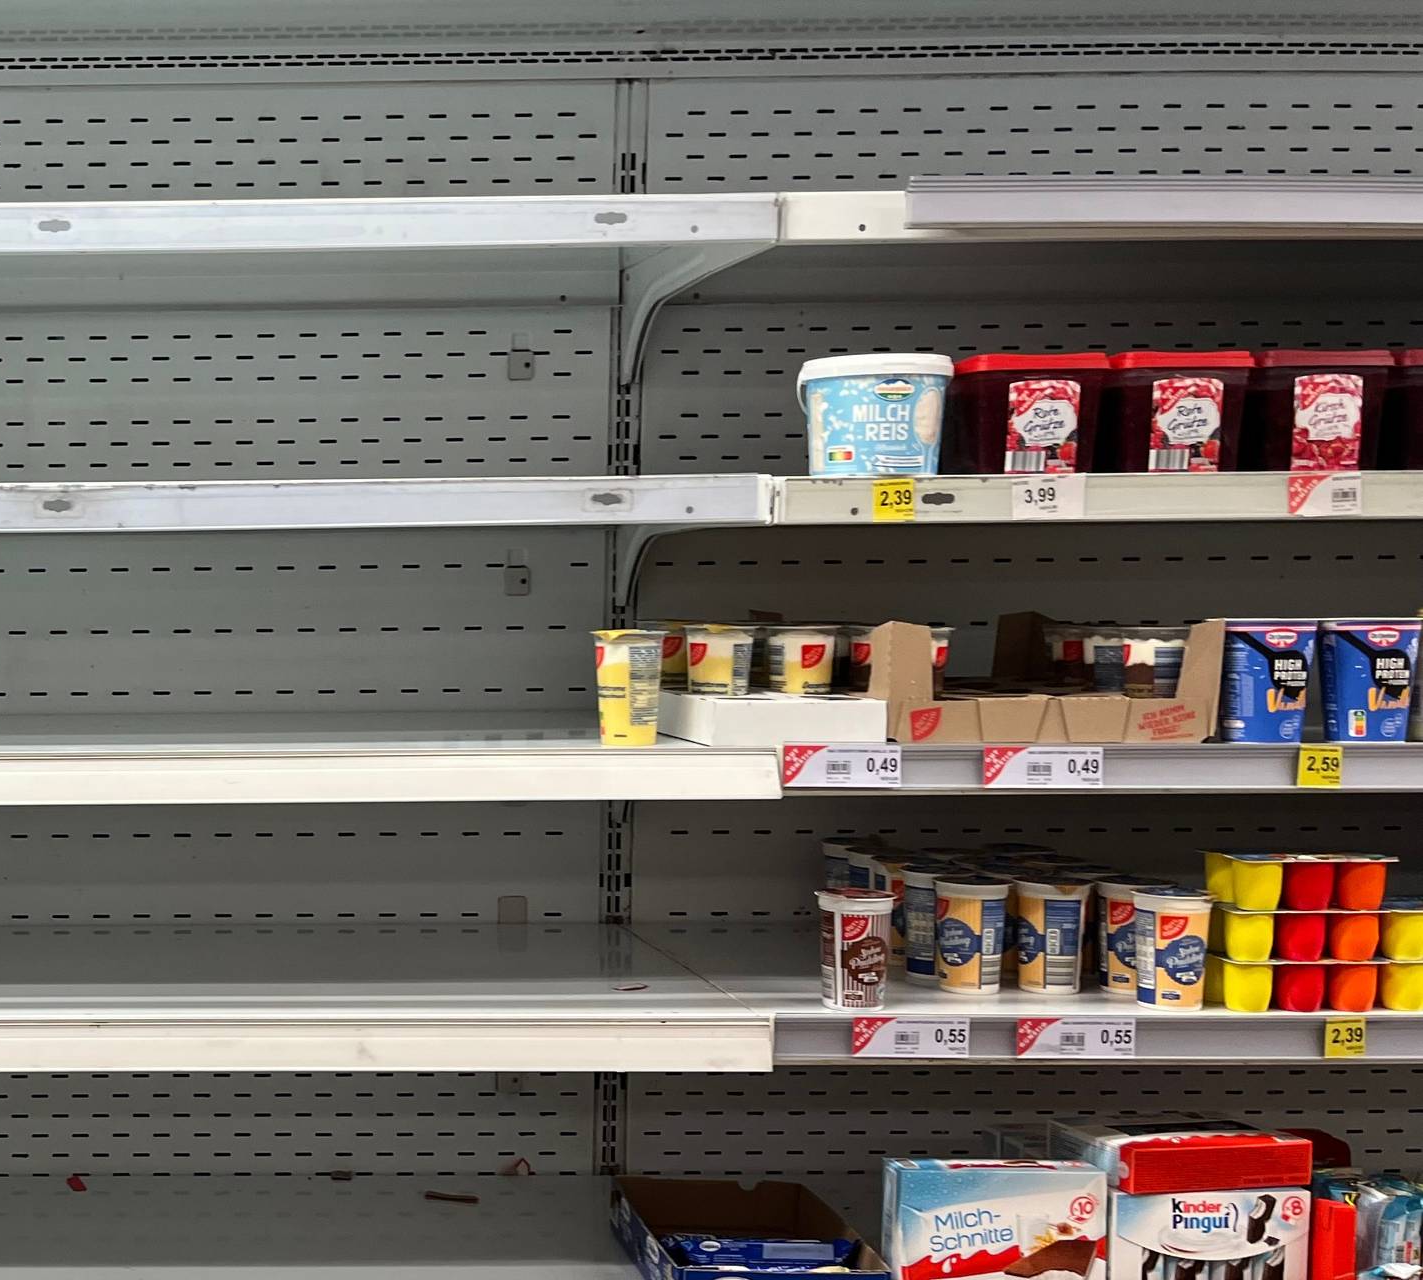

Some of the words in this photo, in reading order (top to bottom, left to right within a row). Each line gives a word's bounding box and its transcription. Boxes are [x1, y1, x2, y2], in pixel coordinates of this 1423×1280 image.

[852, 403, 911, 422] MILCH
[865, 423, 909, 441] REIS
[880, 489, 913, 509] 2,39
[1024, 486, 1056, 506] 3,99
[1274, 658, 1303, 671] HIGH
[1375, 657, 1405, 670] HIGH
[866, 757, 898, 775] 0,49
[1067, 758, 1100, 776] 0,49
[1306, 756, 1340, 774] 2,59
[935, 1028, 967, 1046] 0,55
[1100, 1029, 1133, 1047] 0,55
[1332, 1026, 1364, 1047] 2,39
[933, 1208, 1002, 1233] Milch-
[929, 1226, 1014, 1253] Schnitte
